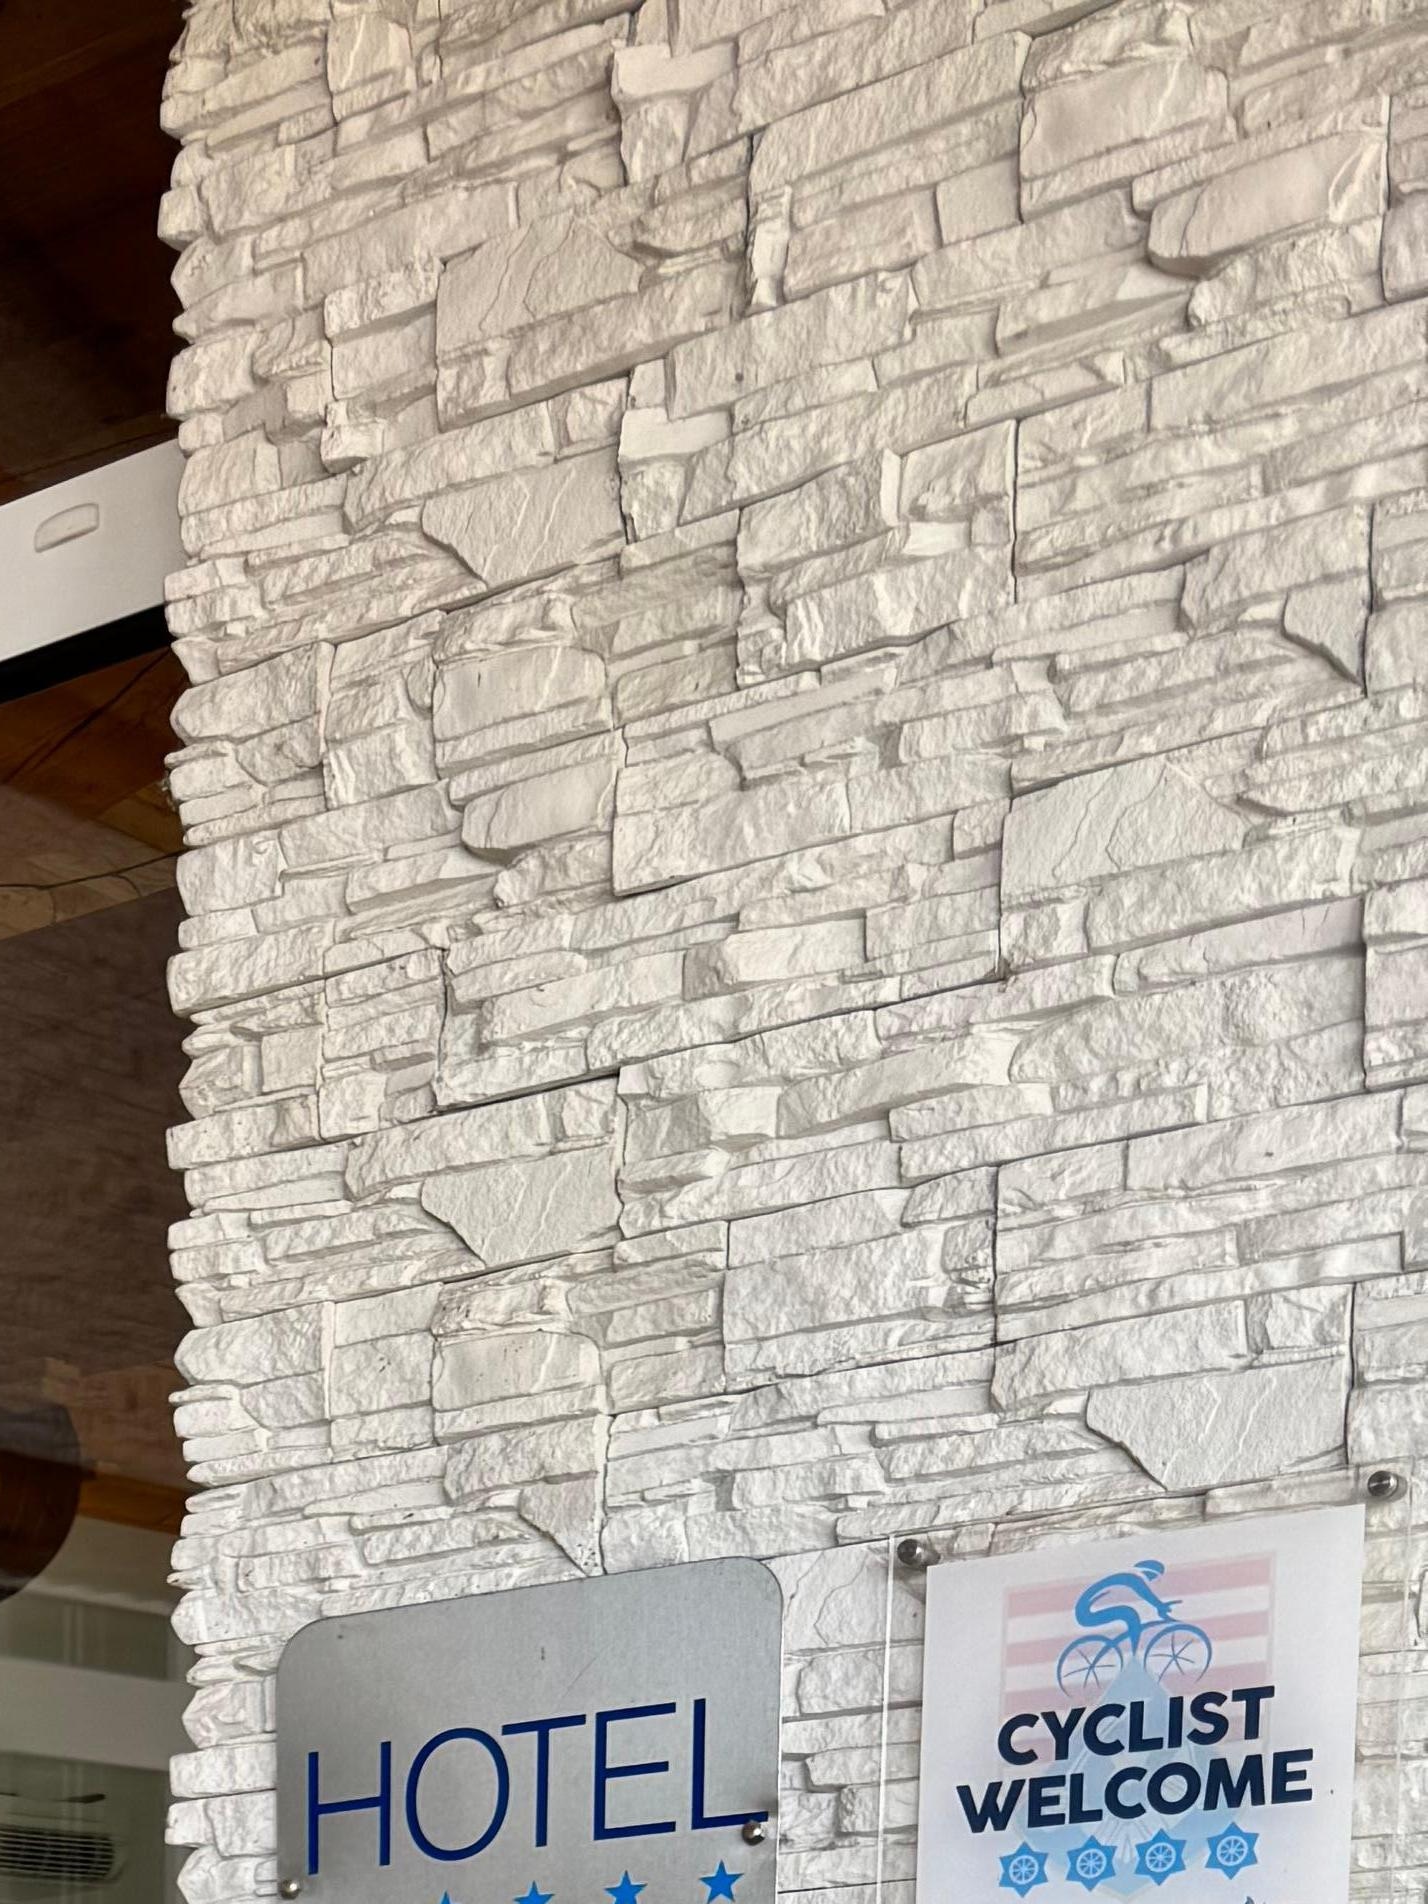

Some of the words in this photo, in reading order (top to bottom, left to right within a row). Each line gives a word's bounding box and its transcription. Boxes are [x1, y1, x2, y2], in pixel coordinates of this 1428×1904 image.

[996, 1685, 1275, 1766] CYCLIST
[307, 1698, 769, 1876] HOTEL
[955, 1748, 1314, 1834] WELCOME
